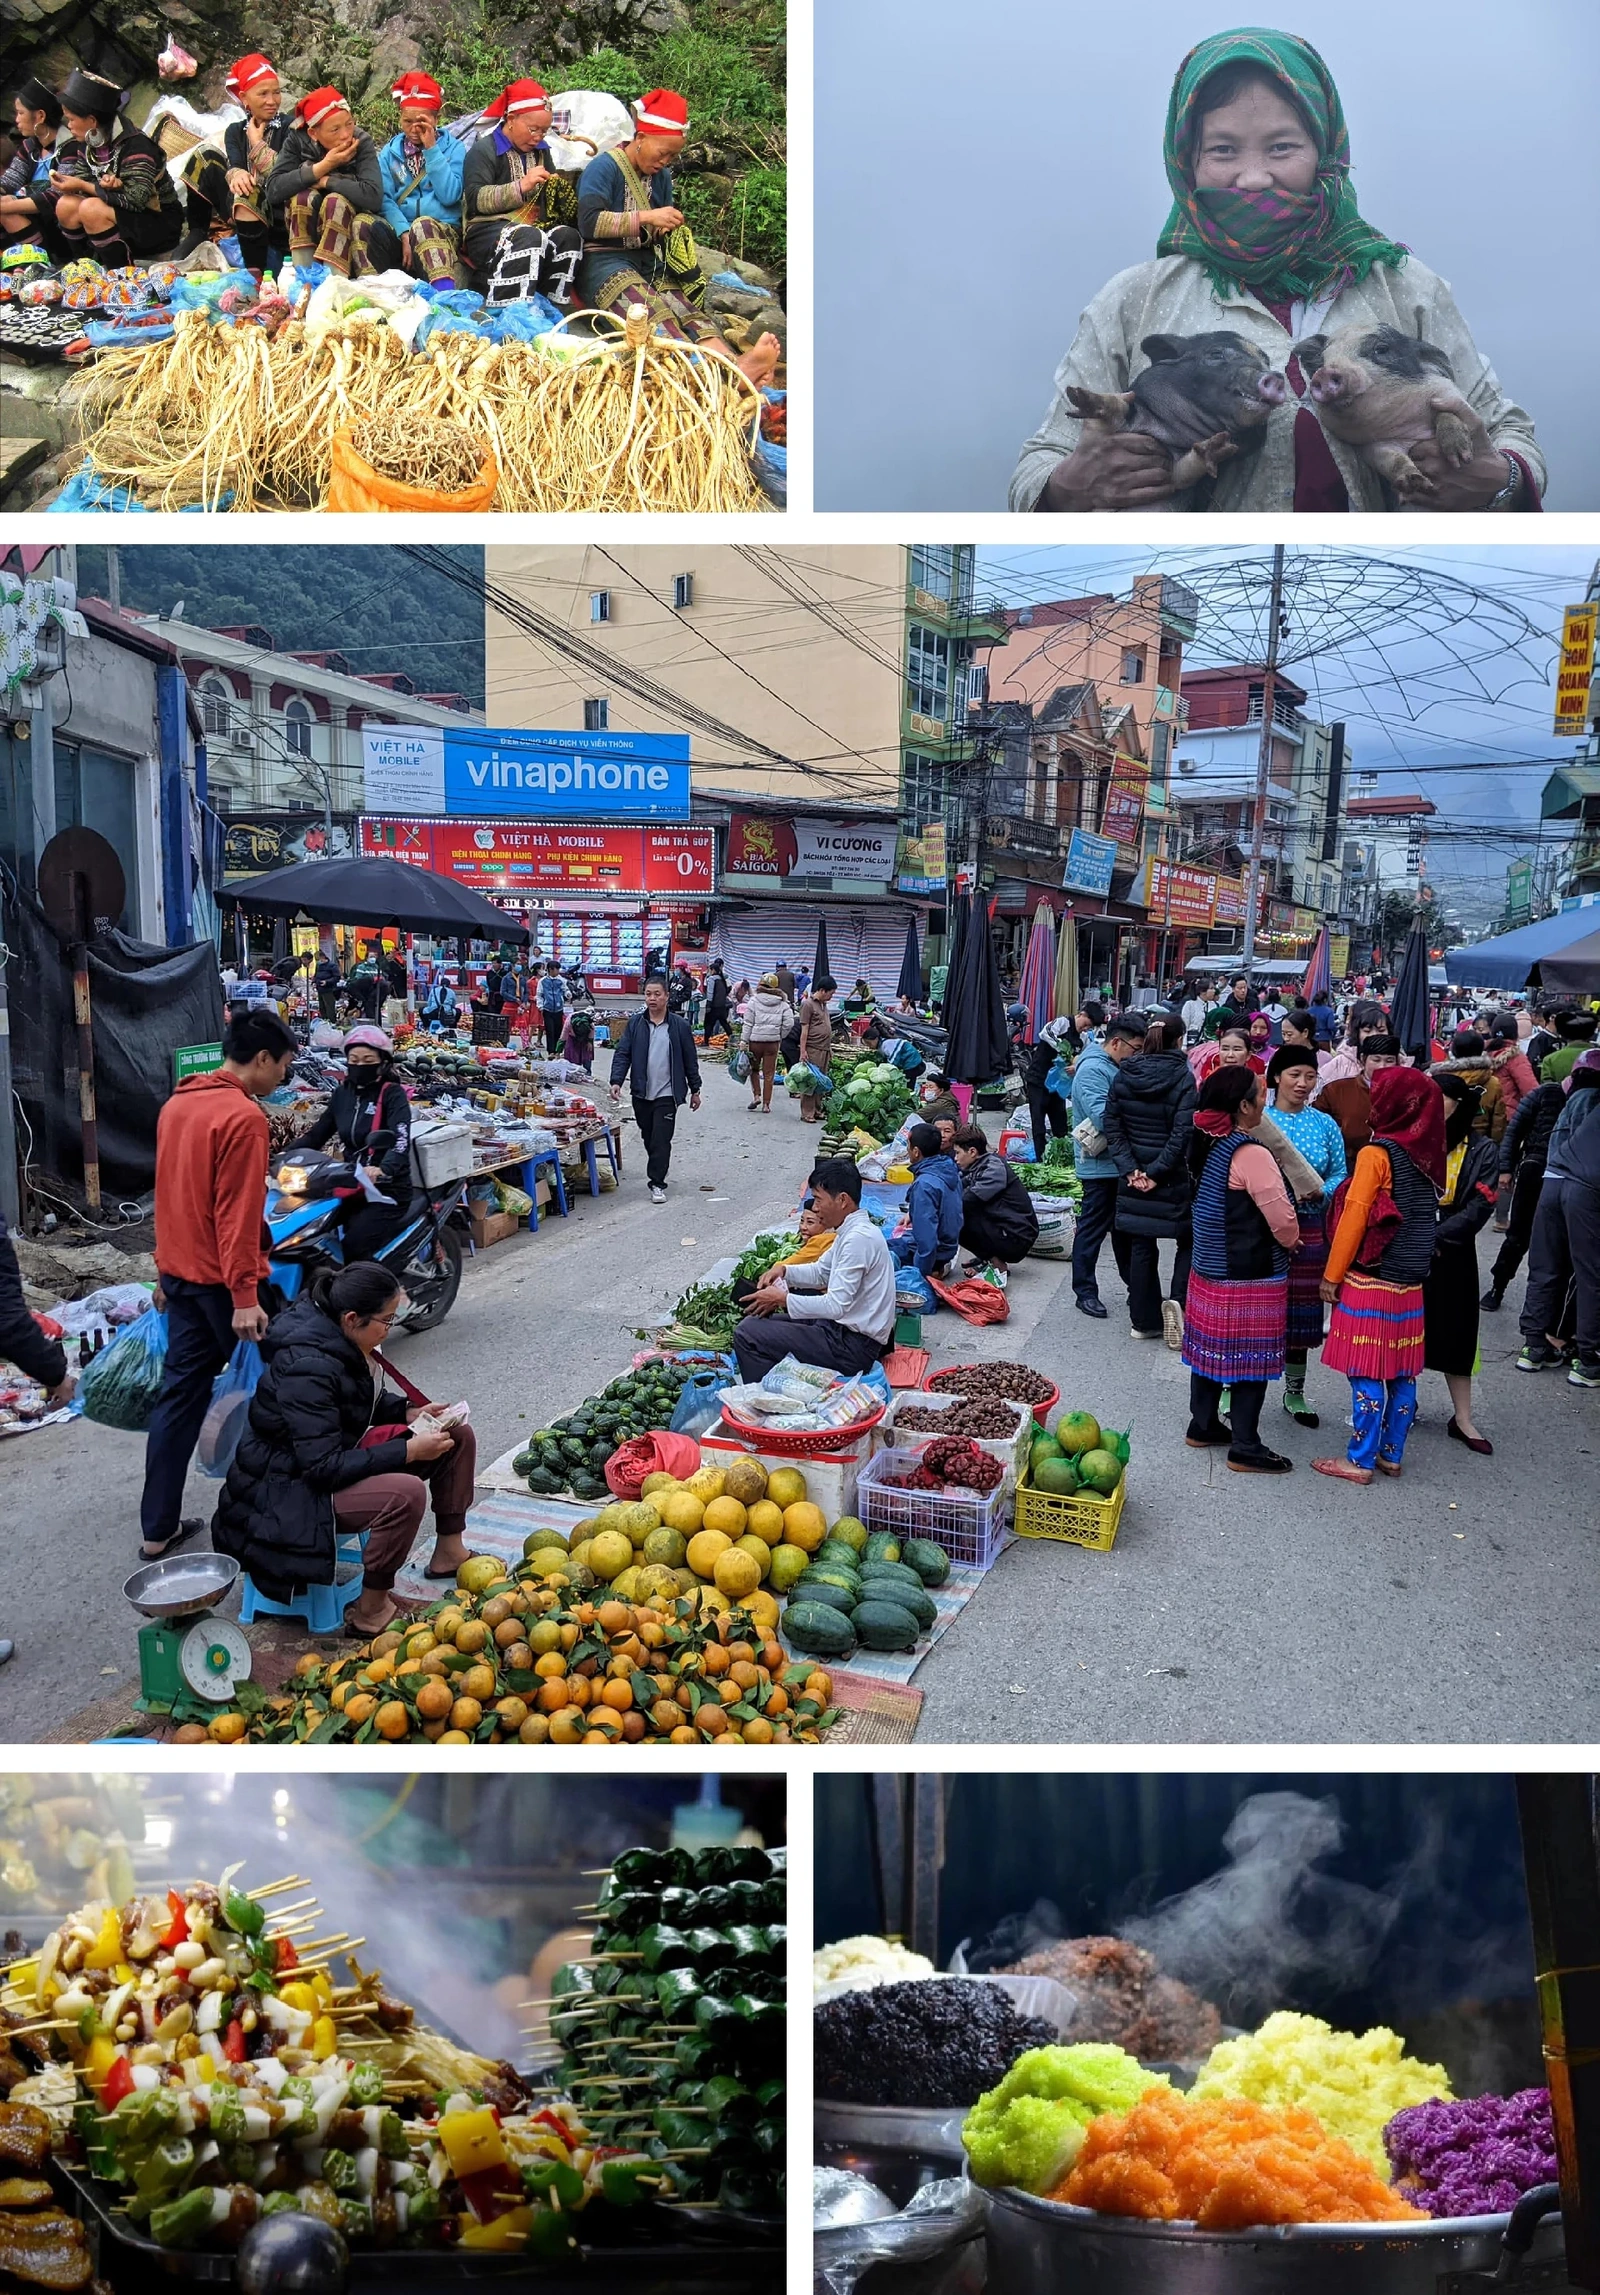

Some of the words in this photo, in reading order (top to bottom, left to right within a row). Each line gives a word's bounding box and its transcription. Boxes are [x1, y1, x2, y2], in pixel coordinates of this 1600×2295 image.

[1558, 671, 1591, 691] QUANG
[370, 739, 402, 755] VIỆT
[406, 740, 425, 753] HÀ
[560, 739, 577, 748] DỊCH
[609, 739, 635, 749] THÔNG
[378, 755, 420, 766] MOBILE
[466, 751, 669, 793] vinaphone
[500, 831, 531, 848] VIỆT
[533, 833, 552, 846] HÀ
[558, 836, 605, 848] MOBILE
[673, 833, 689, 846] TRẢ
[692, 834, 709, 846] GÓP
[816, 836, 830, 849] VI
[469, 850, 489, 861] THOẠI
[750, 853, 764, 861] BIA
[865, 855, 877, 864] CÁC
[732, 859, 779, 873] SAIGON
